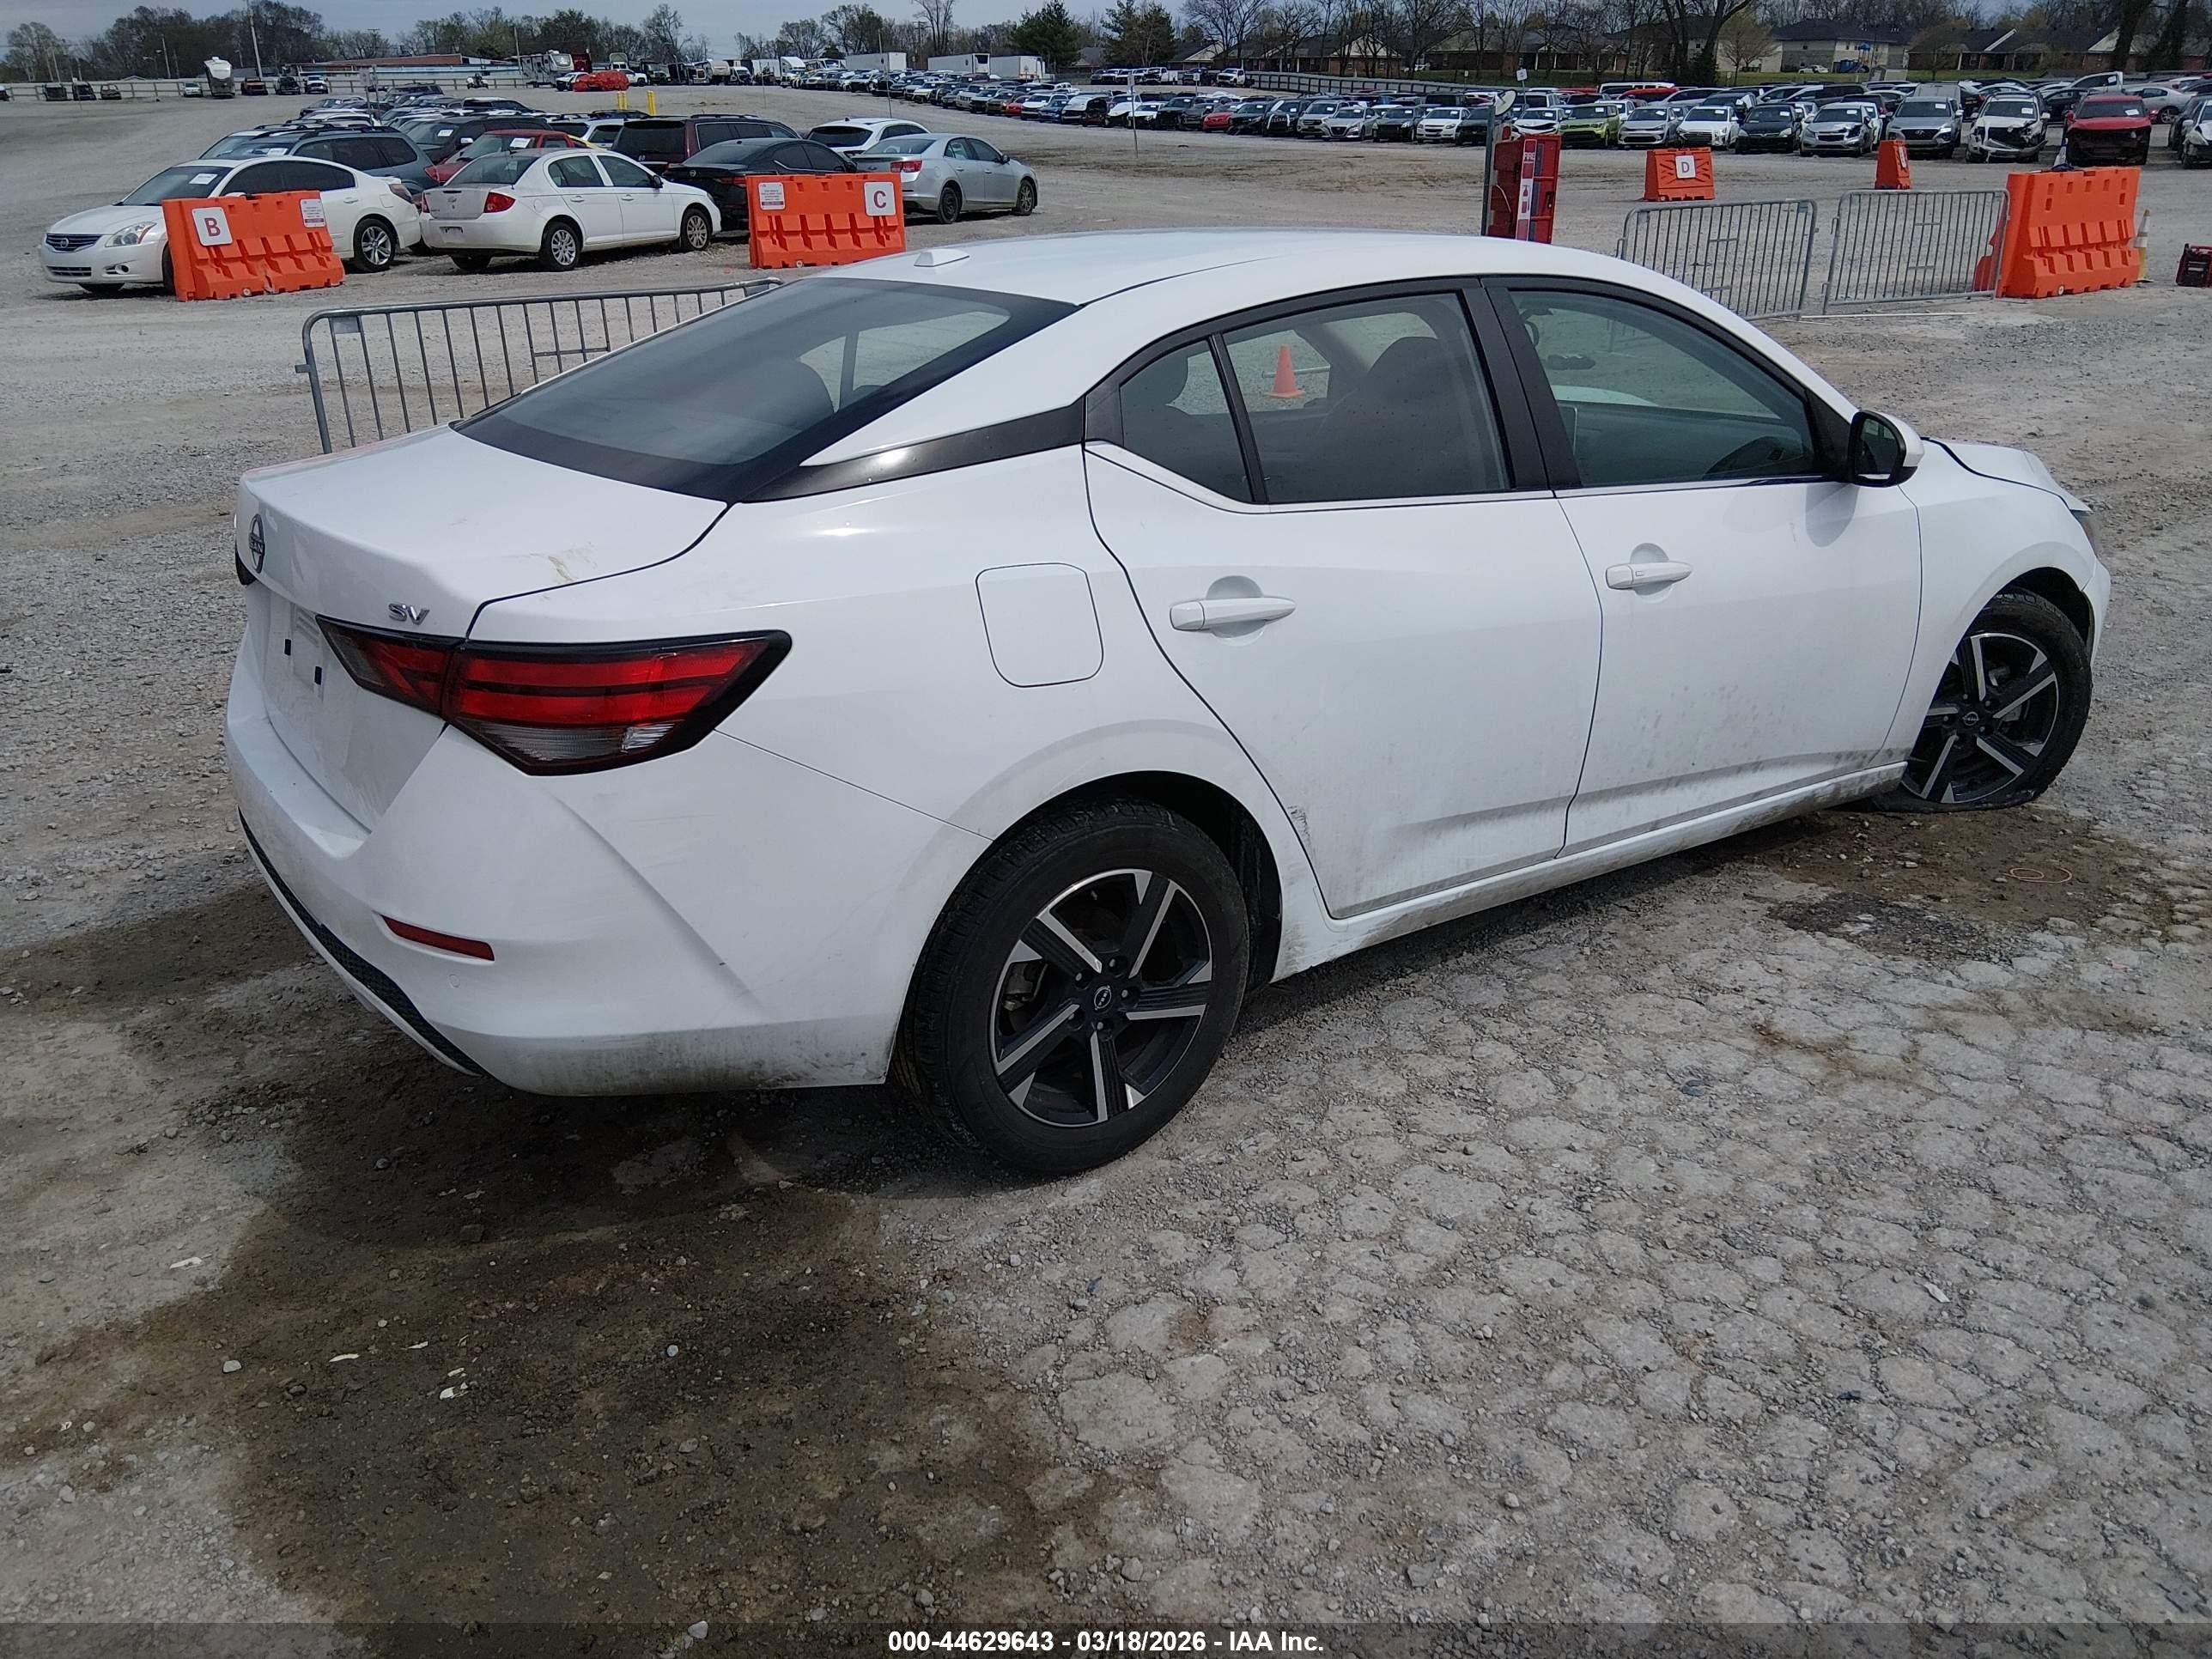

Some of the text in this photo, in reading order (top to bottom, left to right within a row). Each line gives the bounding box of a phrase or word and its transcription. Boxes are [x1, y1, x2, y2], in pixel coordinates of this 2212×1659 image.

[1681, 161, 1689, 173] D
[873, 191, 886, 209] C
[204, 218, 221, 236] B
[388, 603, 429, 625] SV
